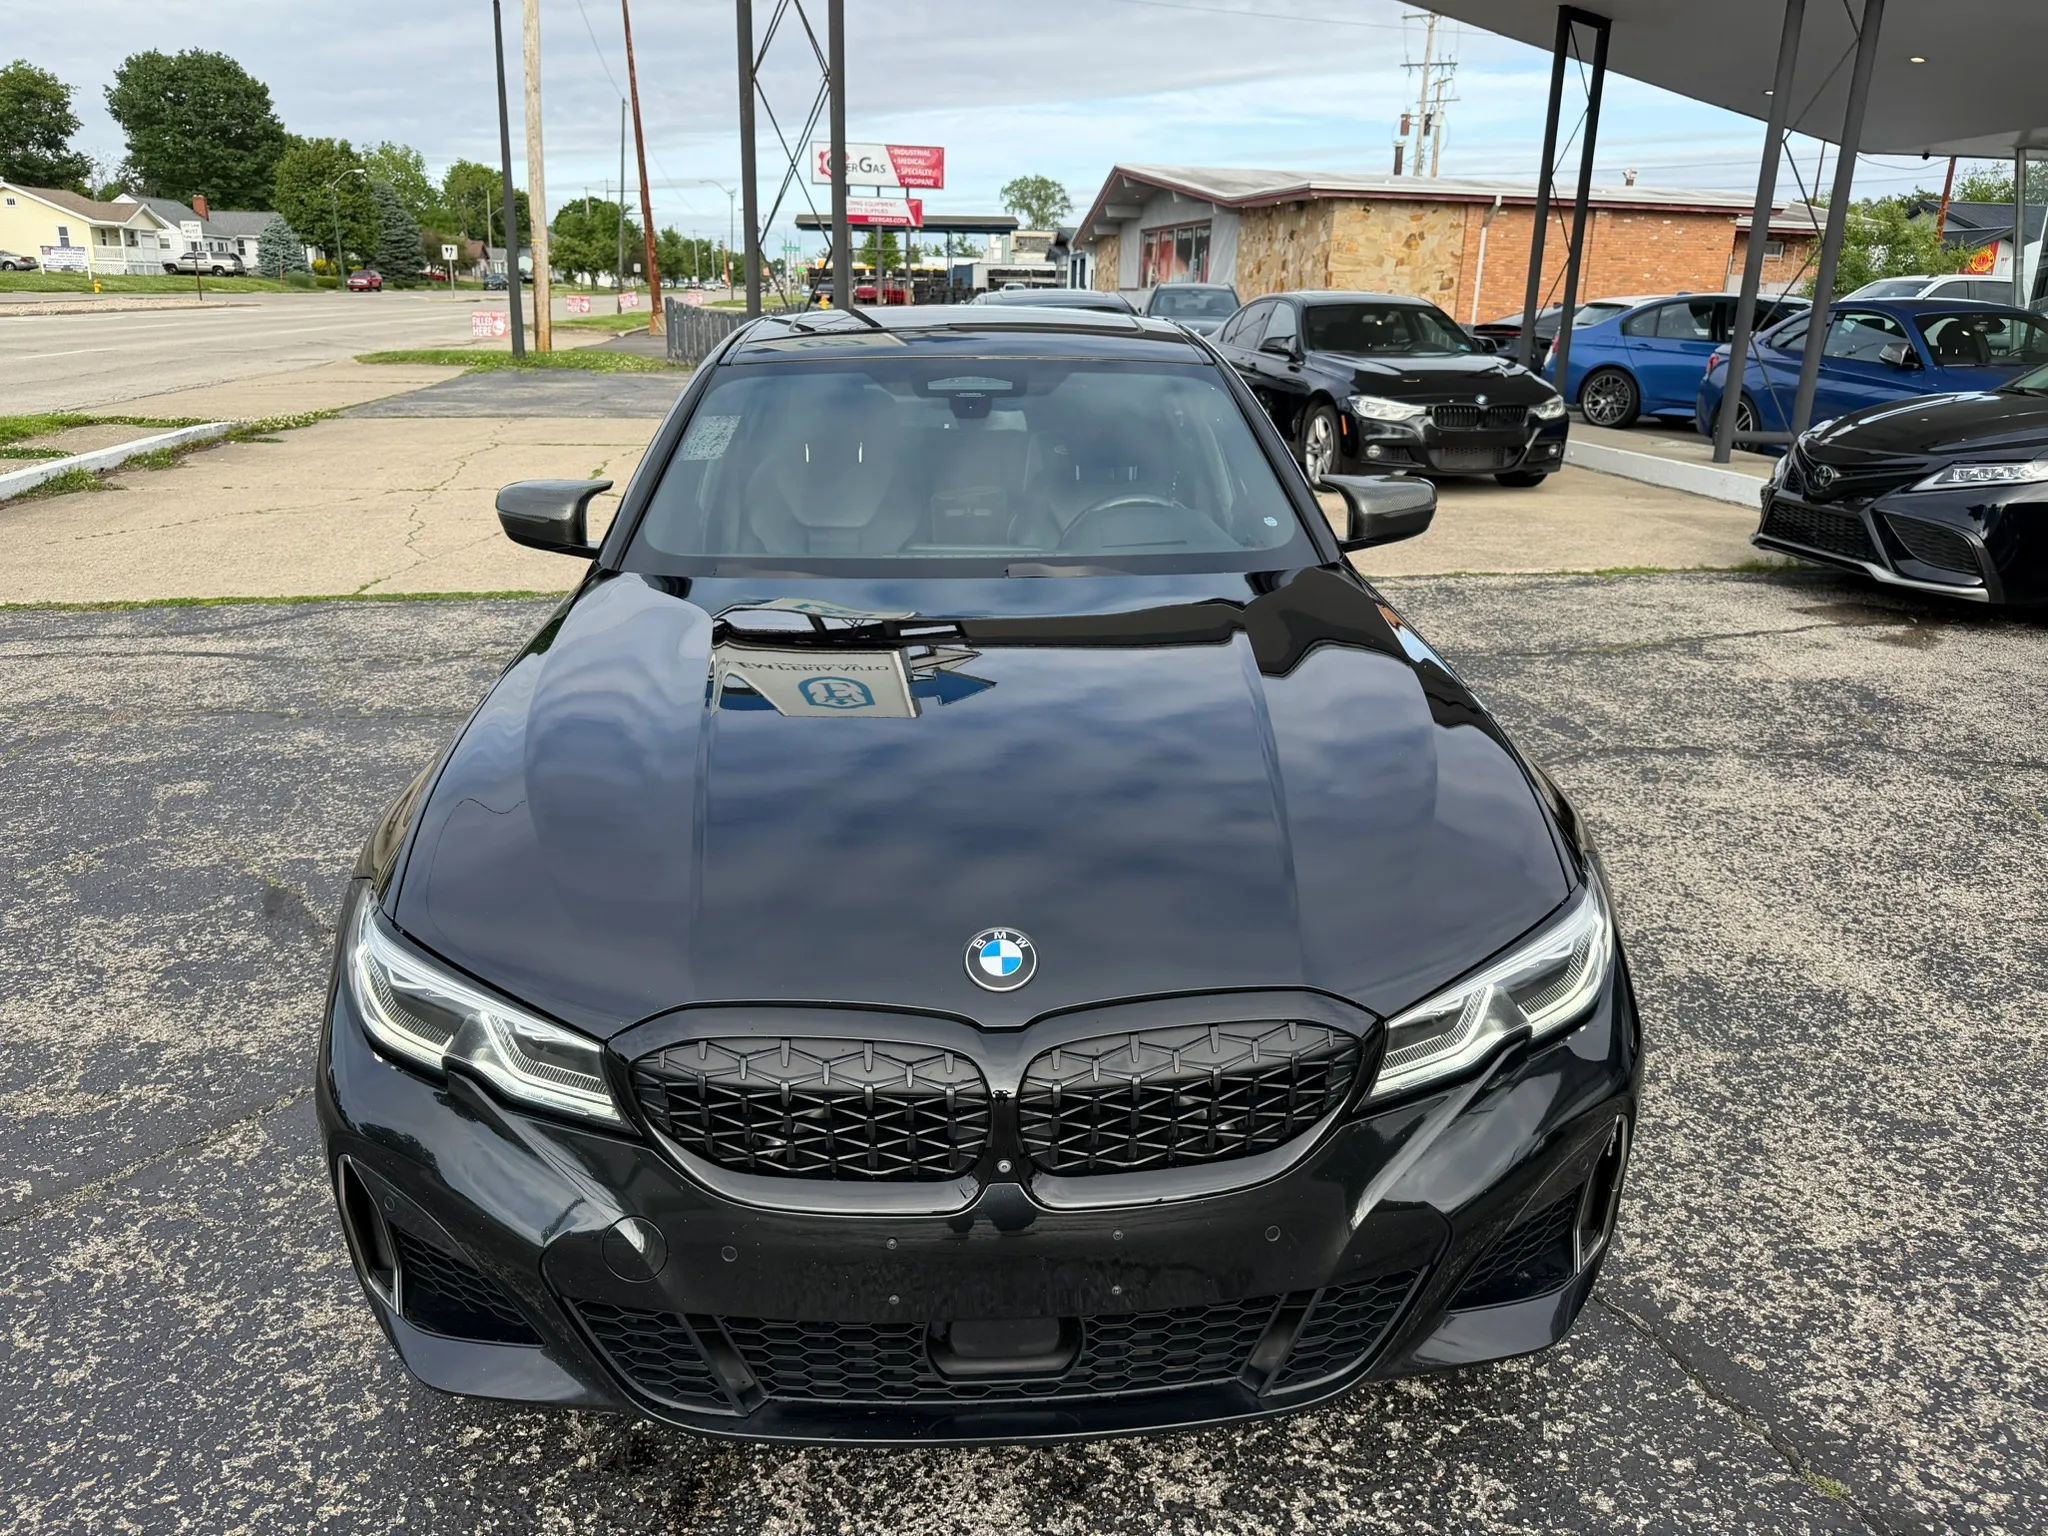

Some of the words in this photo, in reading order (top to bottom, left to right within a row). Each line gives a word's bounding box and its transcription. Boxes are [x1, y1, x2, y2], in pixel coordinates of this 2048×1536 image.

[894, 149, 931, 157] INDUSTRIAL
[897, 158, 926, 166] MEDICAL
[900, 167, 932, 176] SPECIALTY
[904, 178, 935, 186] PROPANE
[472, 317, 493, 326] FILLED
[472, 326, 492, 337] HERE
[973, 931, 1030, 950] BMW
